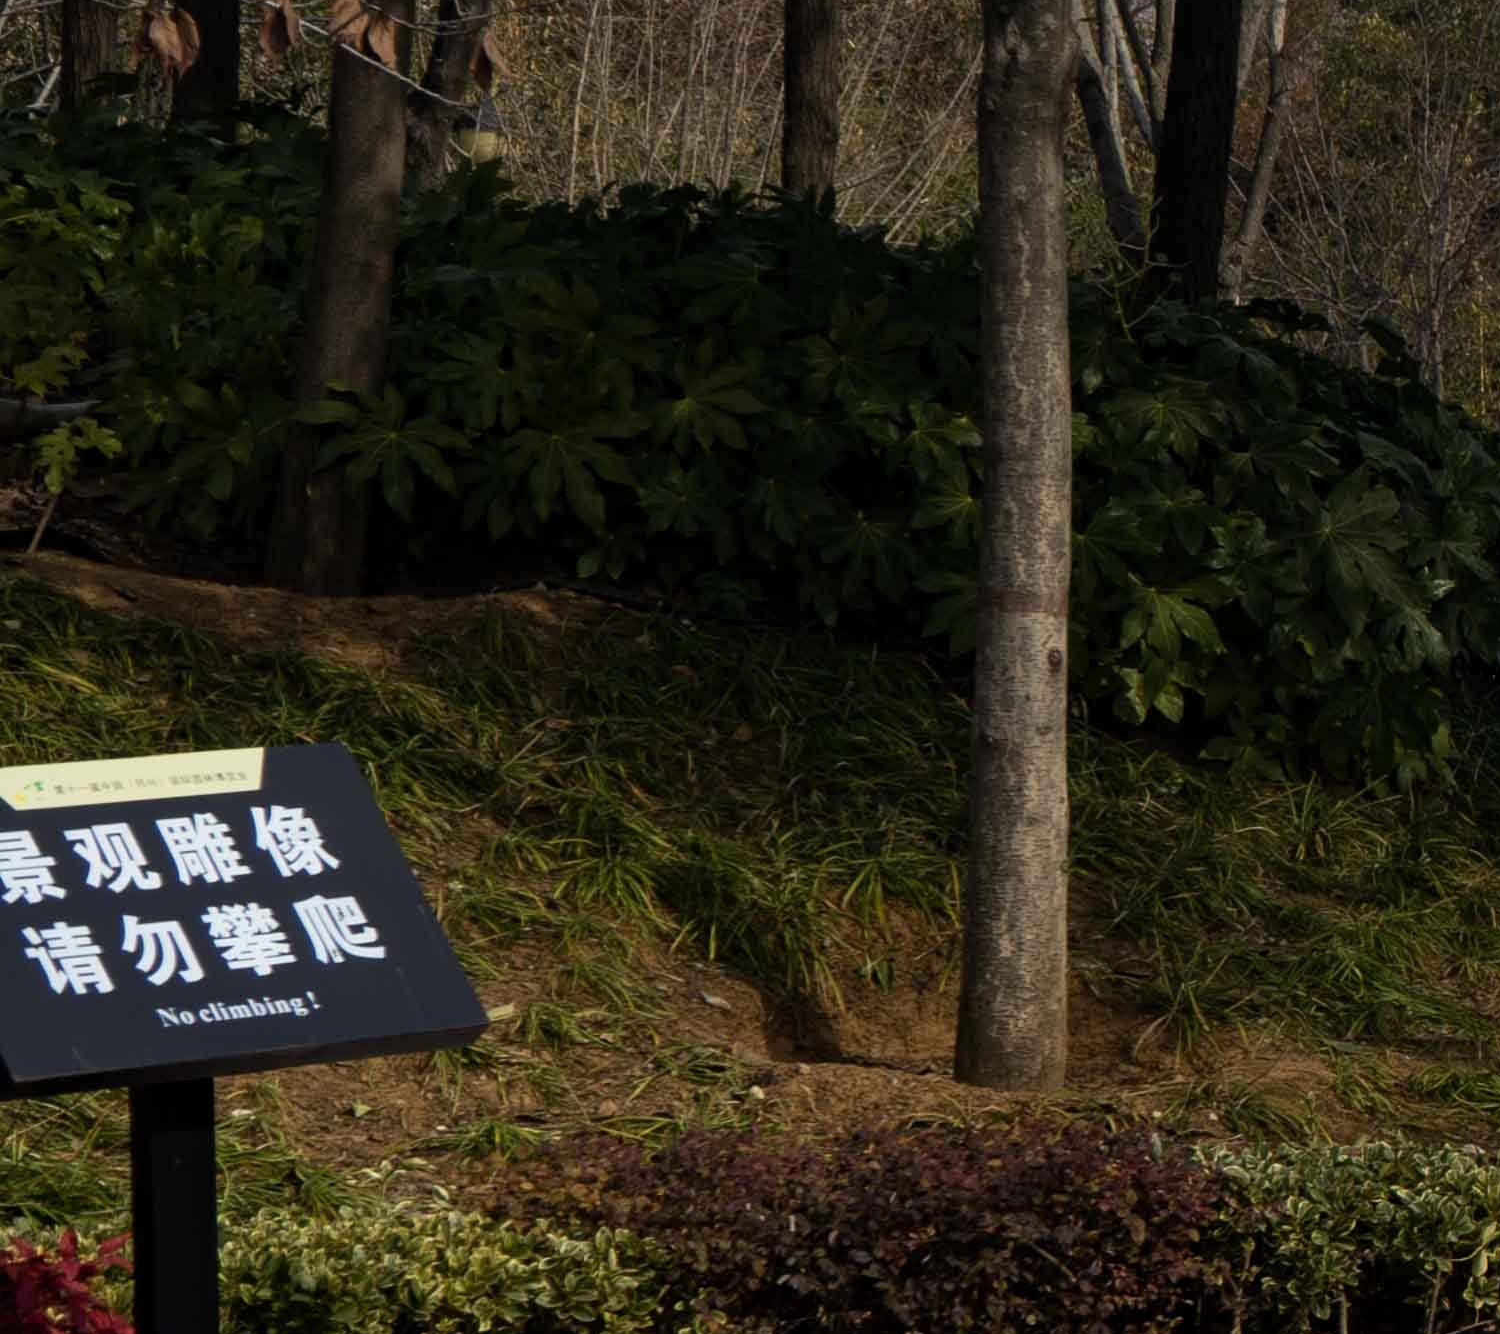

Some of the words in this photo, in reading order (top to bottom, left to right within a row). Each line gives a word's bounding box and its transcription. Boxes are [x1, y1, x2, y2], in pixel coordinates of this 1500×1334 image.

[0, 804, 340, 905] 景观雕像
[22, 895, 386, 995] 请勿攀爬
[156, 1007, 196, 1027] No
